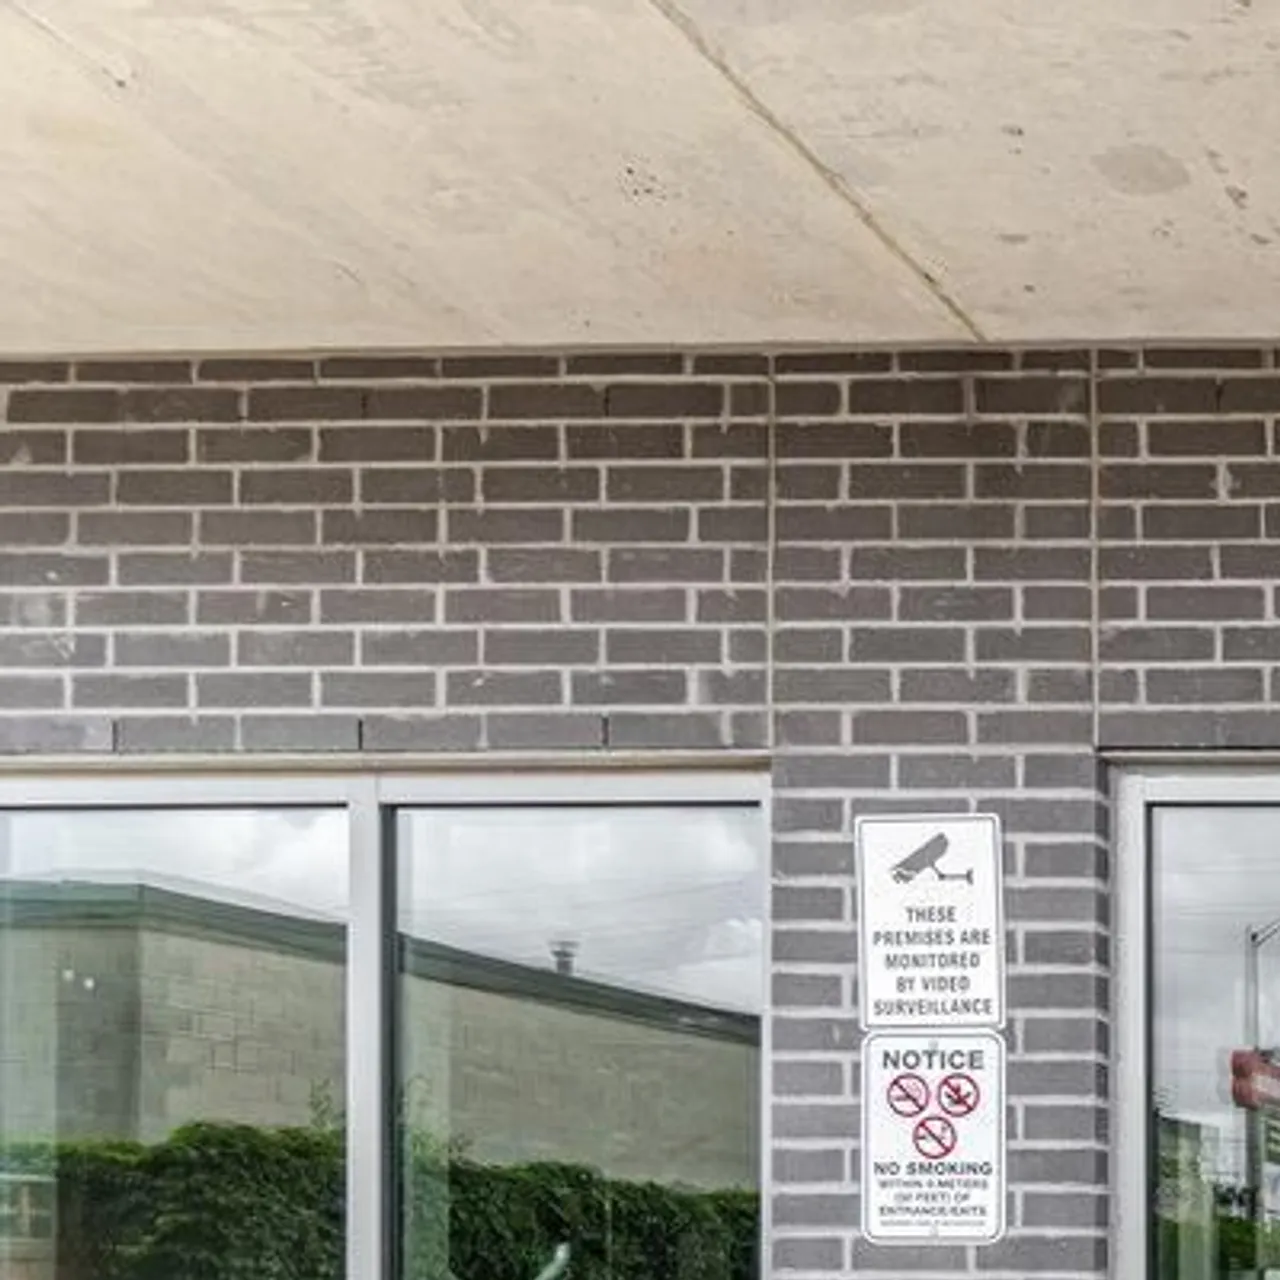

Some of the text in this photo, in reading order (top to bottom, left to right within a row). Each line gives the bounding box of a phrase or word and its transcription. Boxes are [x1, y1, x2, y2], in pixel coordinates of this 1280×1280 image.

[905, 905, 957, 922] THESE
[873, 928, 991, 946] PREMISES ARE
[885, 952, 980, 969] MONITORED
[896, 975, 970, 993] BY VIDEO
[873, 998, 992, 1016] SURVEILLANCE
[883, 1050, 984, 1070] NOTICE
[873, 1161, 993, 1176] NO SMOKING
